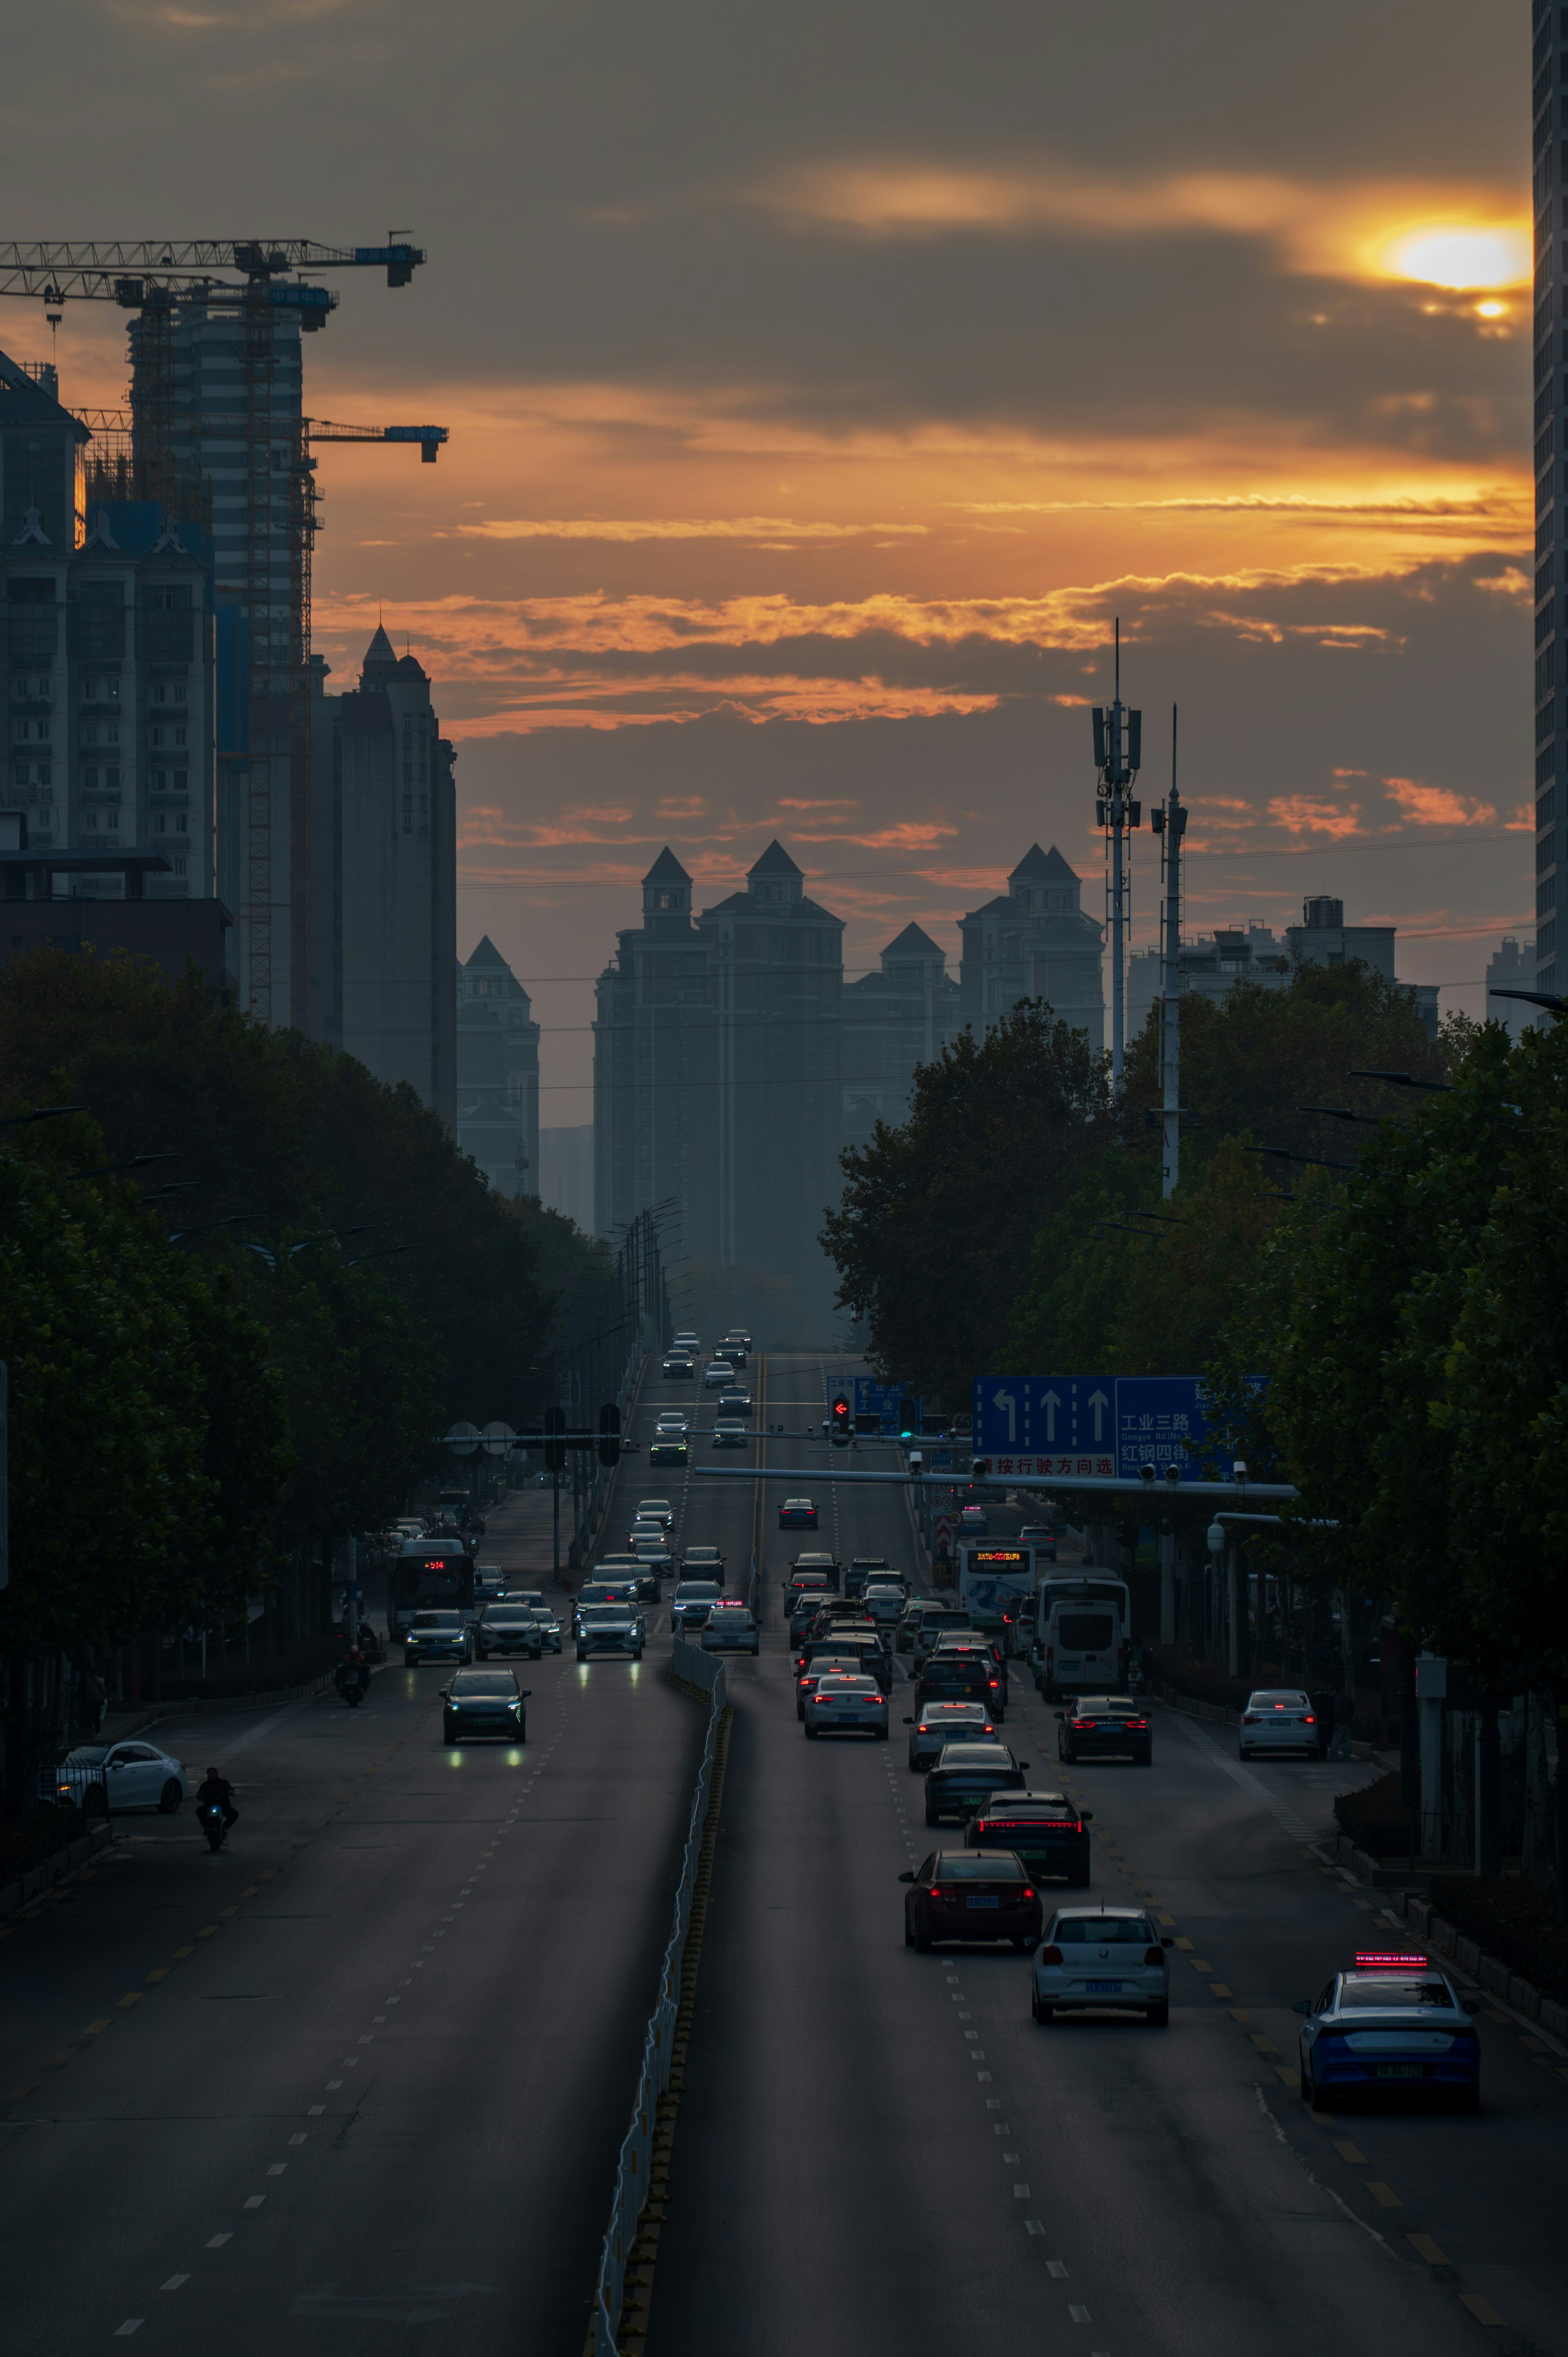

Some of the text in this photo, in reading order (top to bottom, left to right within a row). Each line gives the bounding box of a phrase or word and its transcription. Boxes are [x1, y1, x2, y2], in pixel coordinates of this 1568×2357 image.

[859, 1399, 893, 1410] 工业
[955, 1416, 972, 1429] 60
[1121, 1413, 1189, 1431] 工业三路
[1122, 1433, 1151, 1442] Gongye
[1122, 1444, 1189, 1462] 红钢四街
